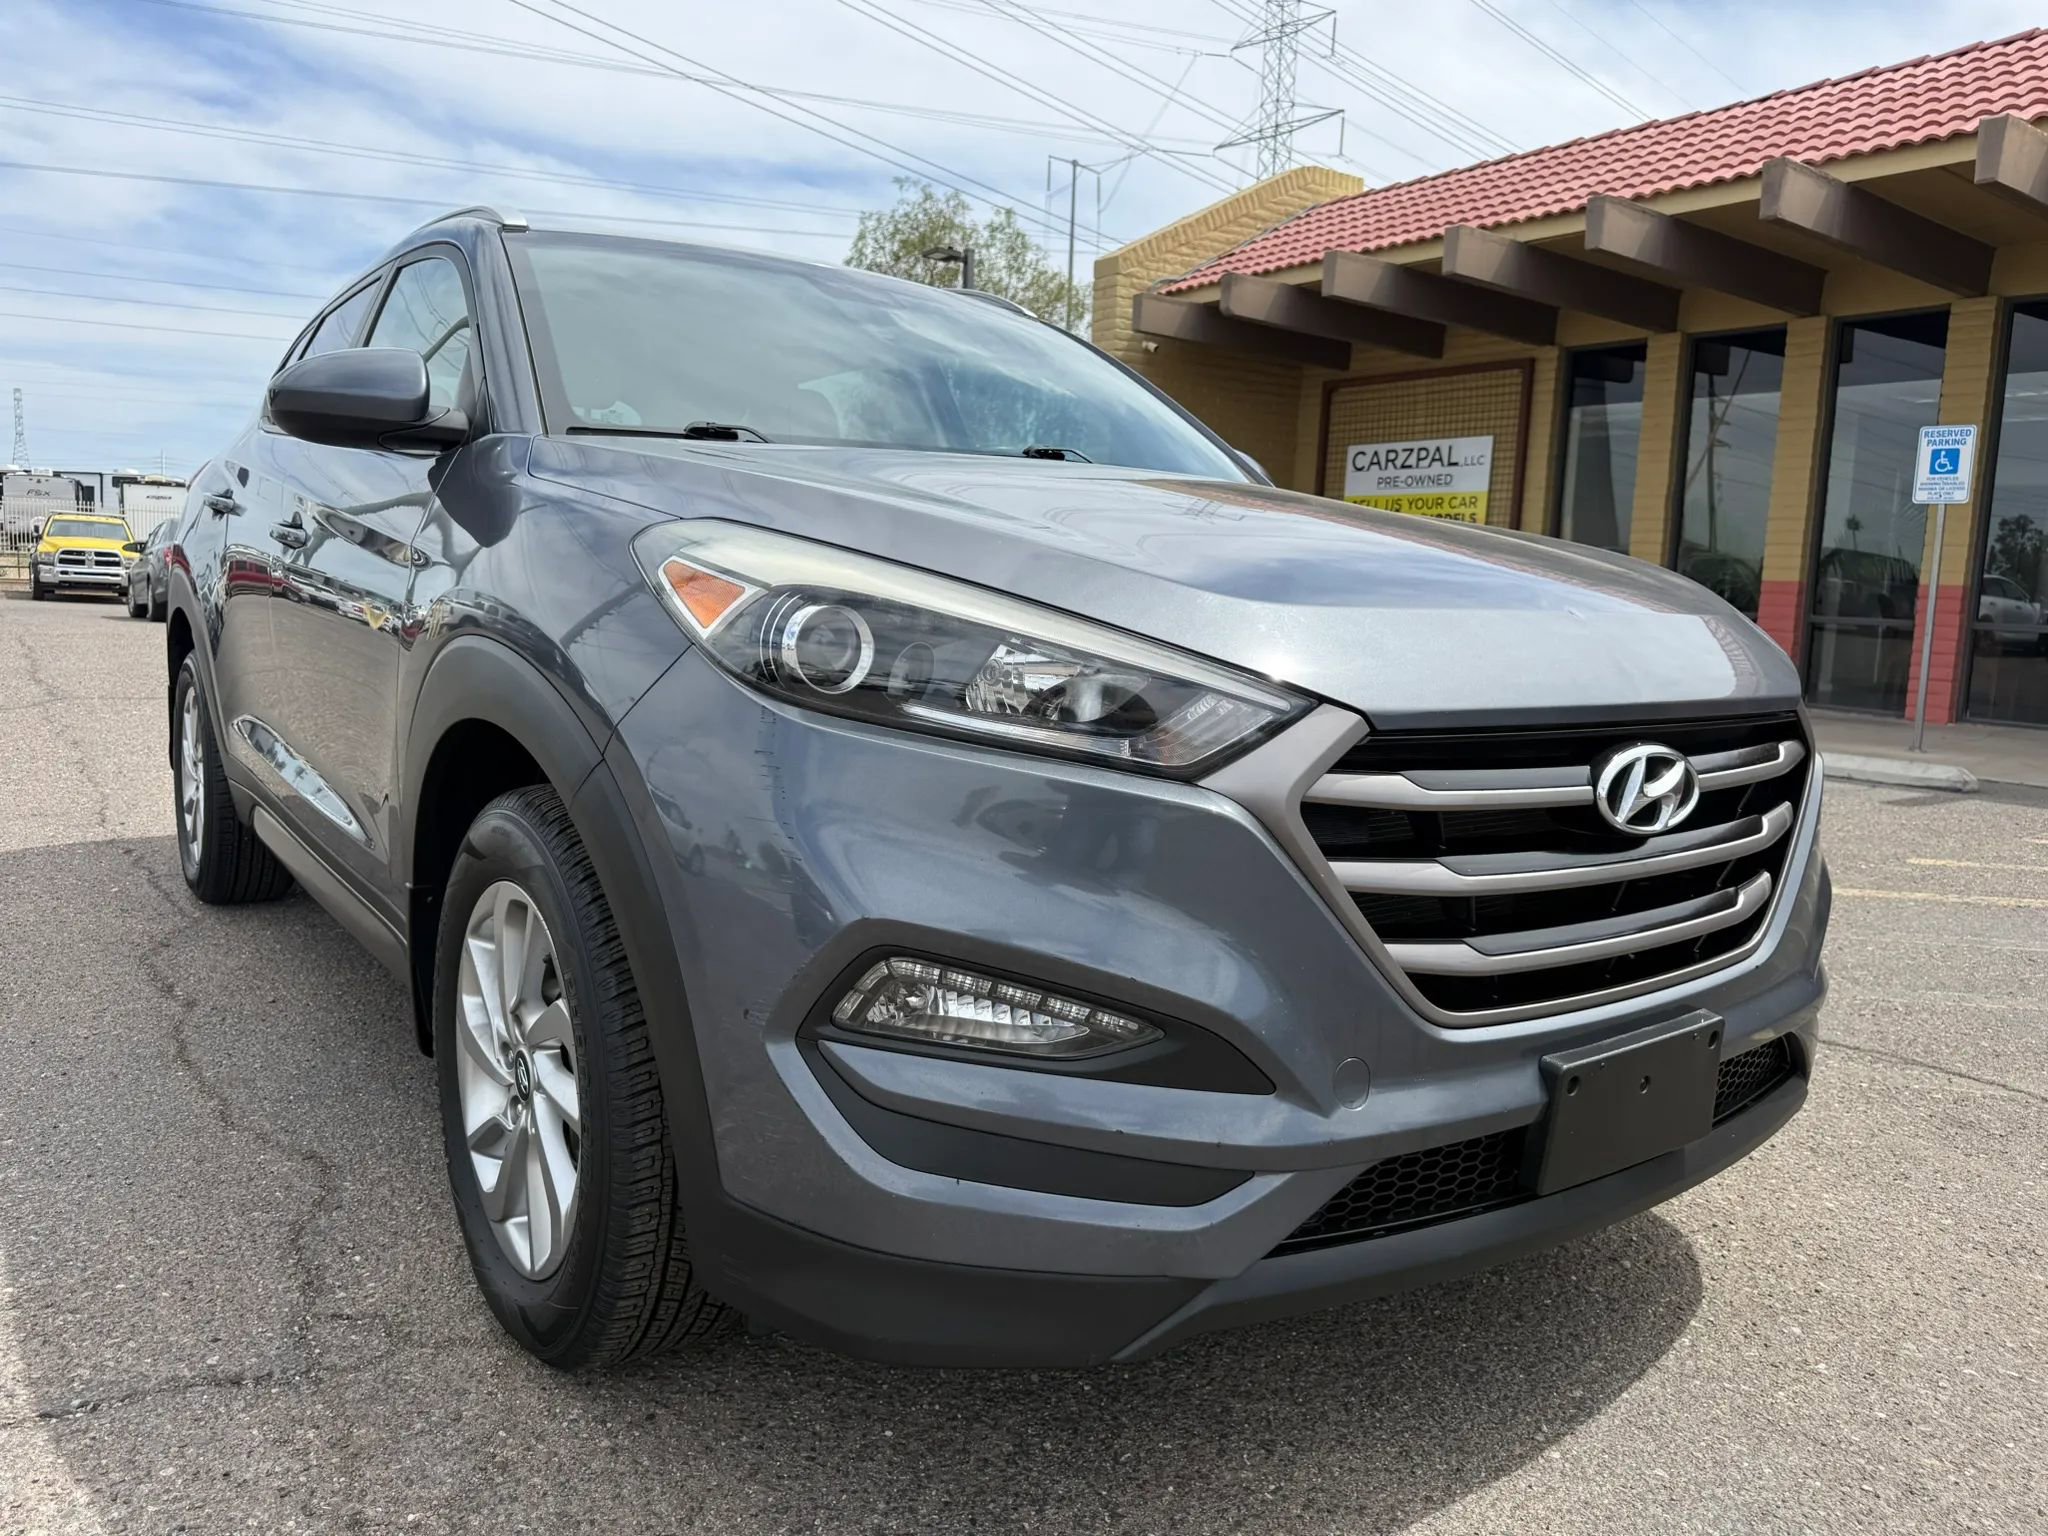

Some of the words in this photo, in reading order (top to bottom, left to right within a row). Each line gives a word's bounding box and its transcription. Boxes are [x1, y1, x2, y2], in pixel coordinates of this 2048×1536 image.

[1924, 429, 1972, 439] RESERVED
[1926, 438, 1967, 447] PARKING
[1377, 474, 1454, 488] PRE-OWNED
[1407, 497, 1444, 511] YOUR
[1448, 496, 1478, 509] CAR
